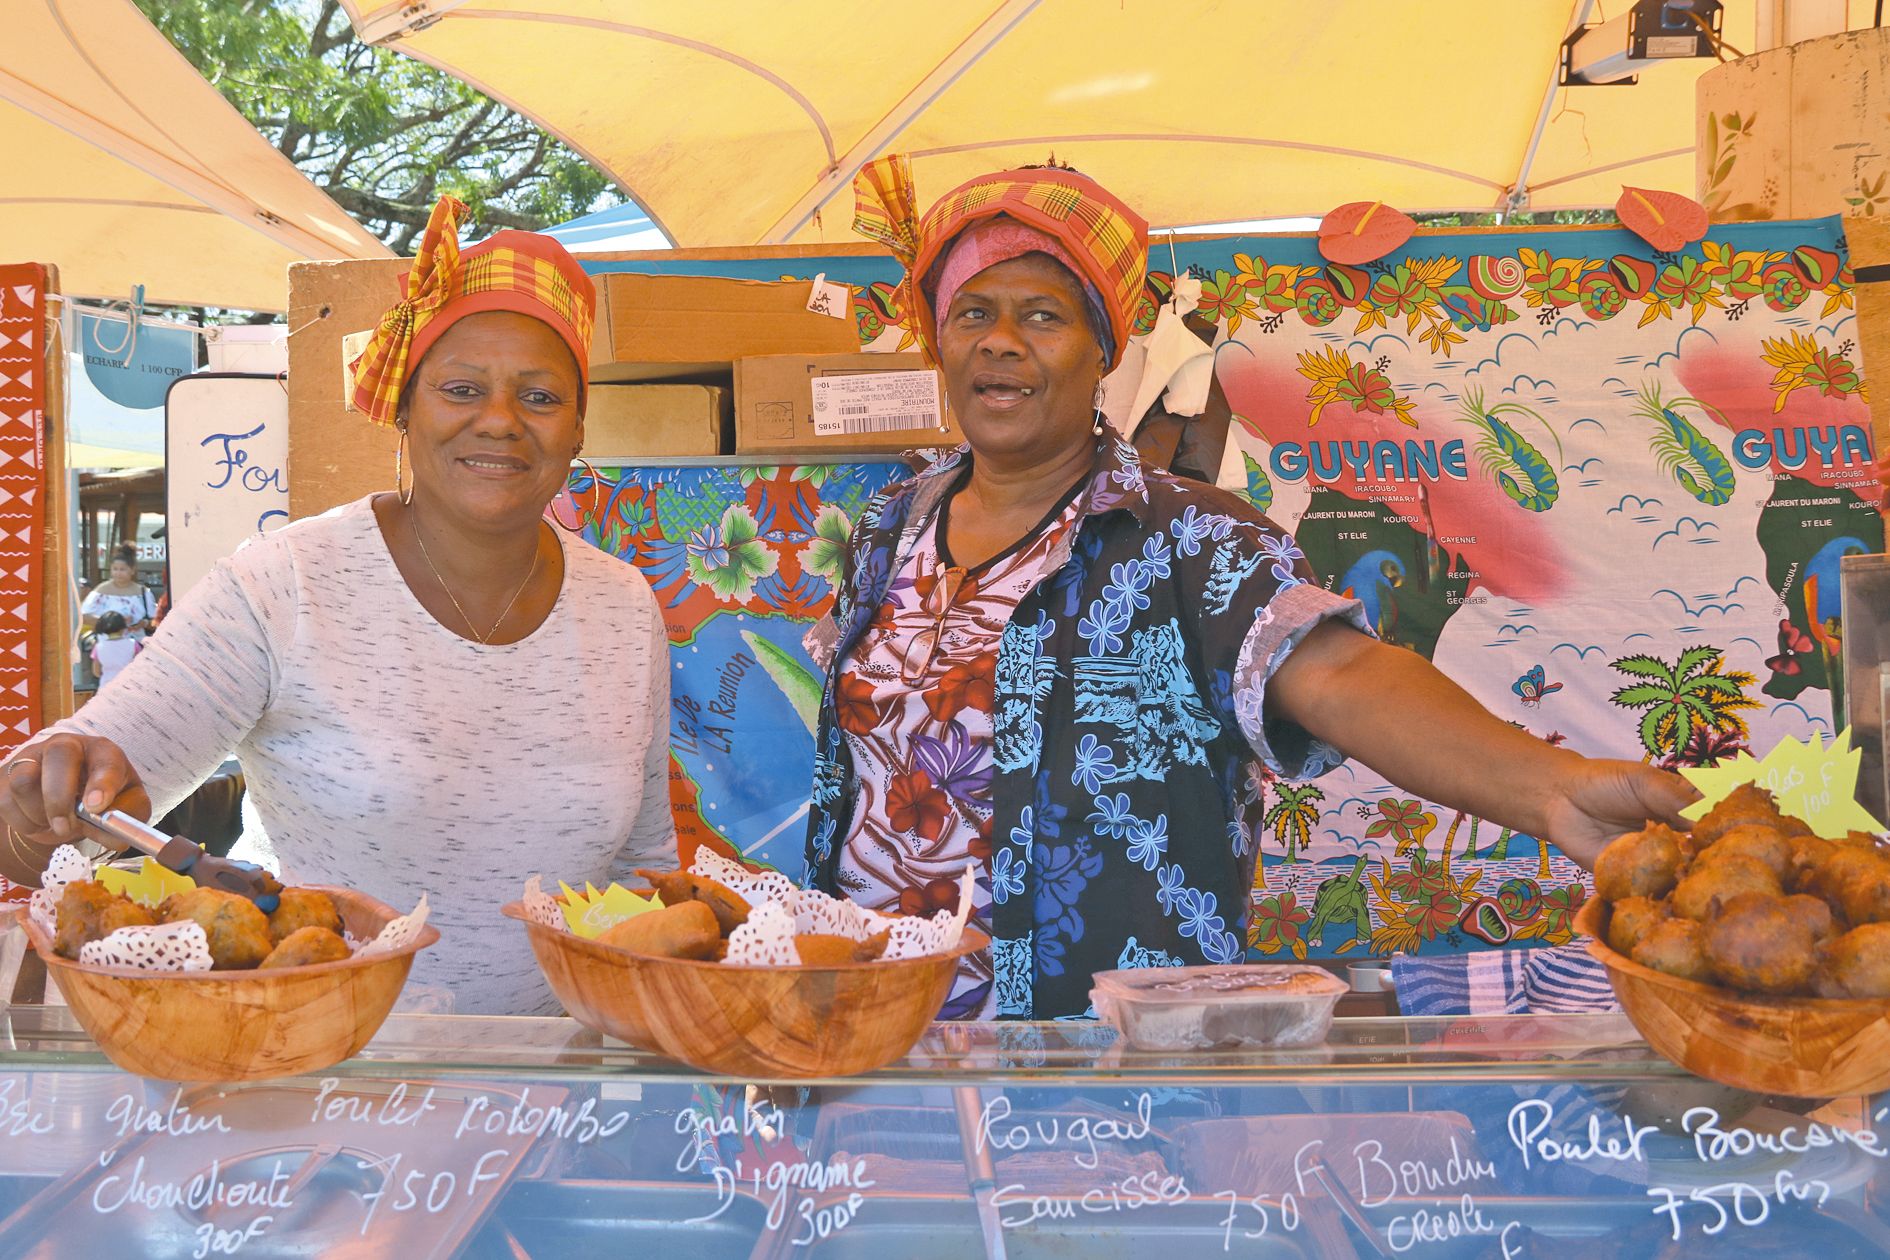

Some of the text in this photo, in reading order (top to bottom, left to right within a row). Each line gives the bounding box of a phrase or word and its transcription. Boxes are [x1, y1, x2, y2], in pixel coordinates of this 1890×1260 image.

[165, 367, 183, 376] CFP
[818, 422, 841, 431] 15185
[1269, 438, 1468, 484] GUYANE
[1766, 473, 1792, 481] MANA
[1820, 470, 1865, 479] IRACOUBO
[1303, 486, 1329, 494] MANA
[1355, 485, 1397, 493] IRACOUBO
[1368, 496, 1415, 504] SINNAMARY
[1766, 499, 1799, 508] LAURENT
[1800, 498, 1811, 506] DU
[1812, 497, 1841, 506] MARONI
[1849, 500, 1881, 509] KOURO
[1303, 511, 1336, 519] LAURENT
[1348, 510, 1376, 518] MARONI
[1383, 515, 1419, 523] KOUROU
[1801, 519, 1833, 528] ST ELIE
[1338, 532, 1348, 540] ST
[1440, 536, 1477, 544] CAYENNE
[1448, 571, 1481, 579] REGINA
[1446, 590, 1457, 598] ST
[1446, 597, 1488, 605] GEORGES
[311, 1076, 436, 1127] Poulet
[975, 1092, 1152, 1170] Rougail
[1507, 1098, 1660, 1171] Poulet
[356, 1150, 509, 1235] 750 F
